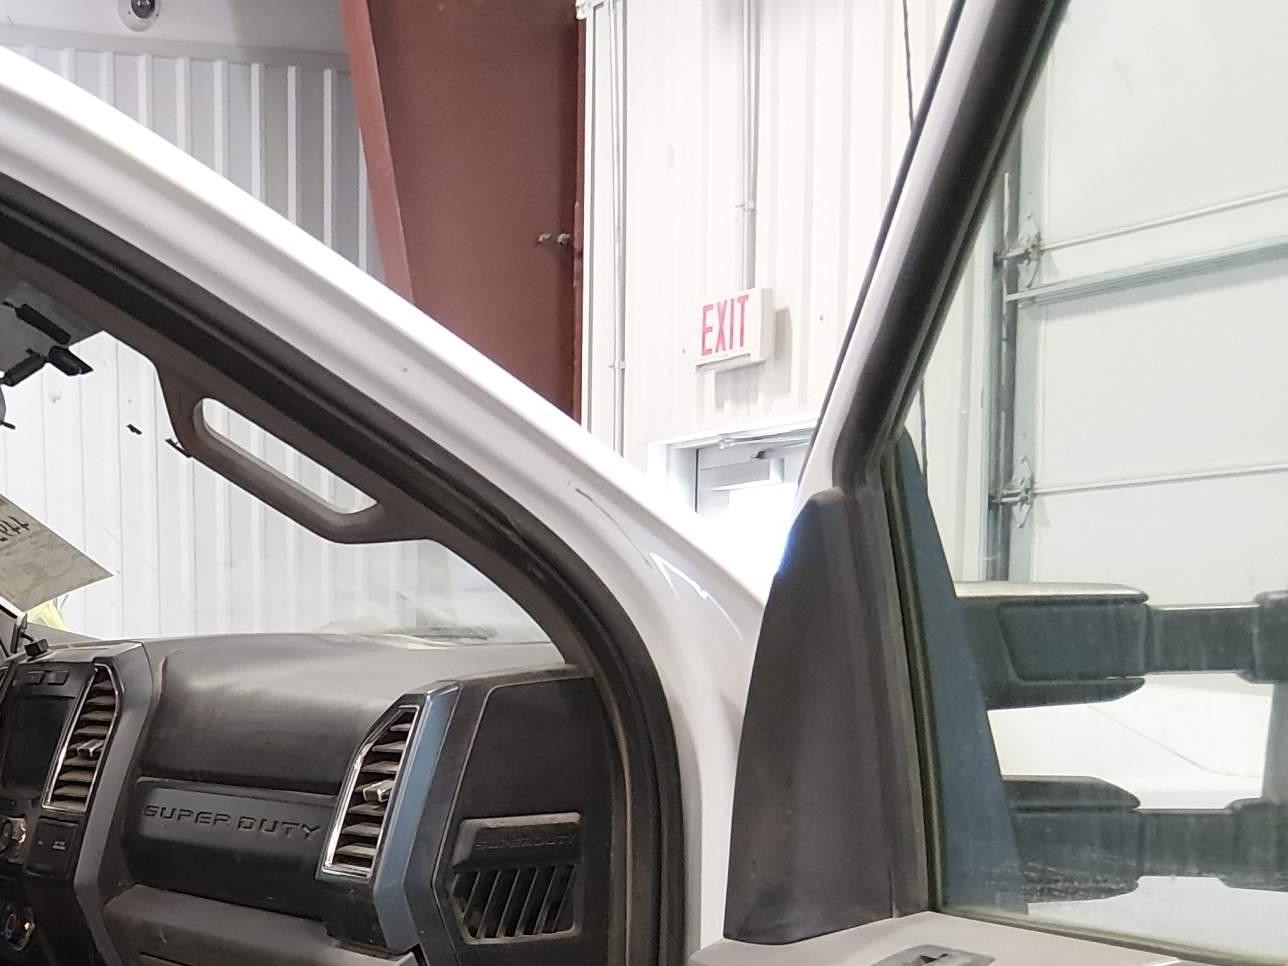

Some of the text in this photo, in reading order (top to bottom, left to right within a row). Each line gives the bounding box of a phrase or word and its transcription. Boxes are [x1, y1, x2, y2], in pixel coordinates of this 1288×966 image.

[701, 294, 749, 356] EXIT
[142, 804, 321, 840] SUPER DUTY
